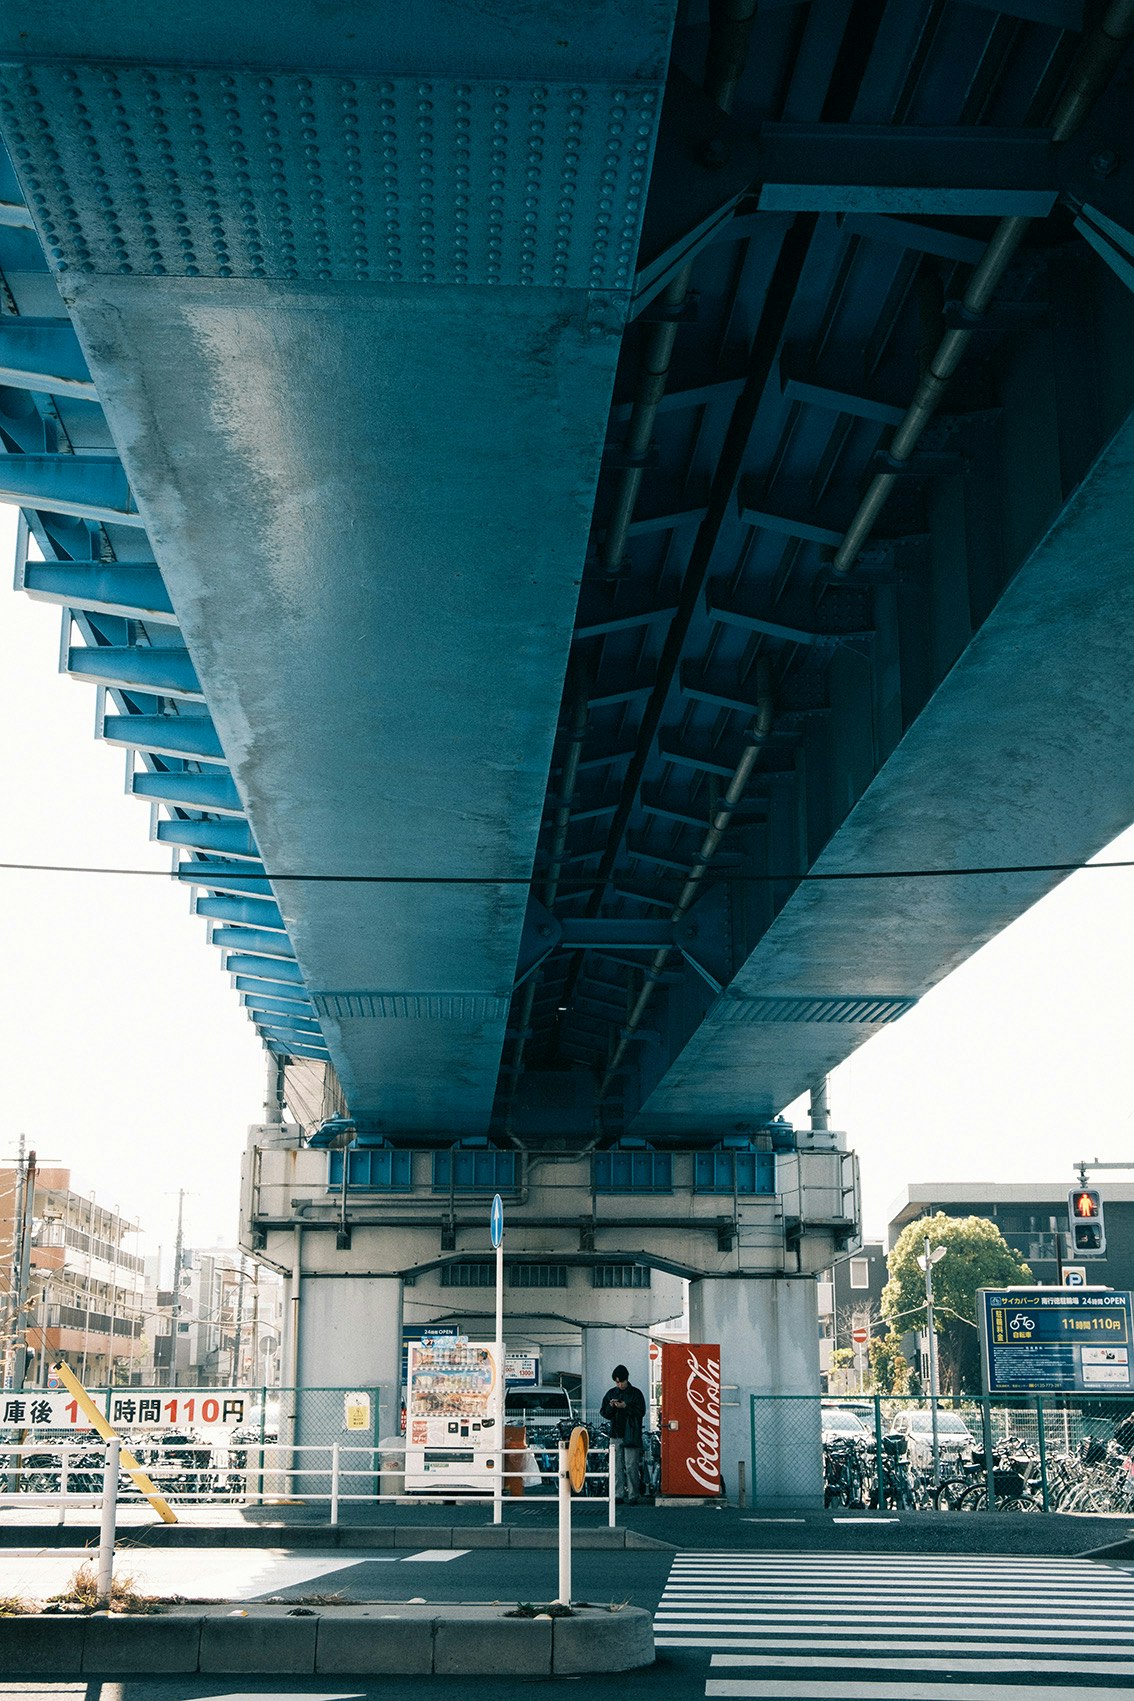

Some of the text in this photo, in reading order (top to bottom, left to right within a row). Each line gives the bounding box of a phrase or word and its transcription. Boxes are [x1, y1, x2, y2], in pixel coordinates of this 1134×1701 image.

[1001, 1297, 1040, 1305] サイカパーク
[687, 1349, 720, 1491] Coca-Cola
